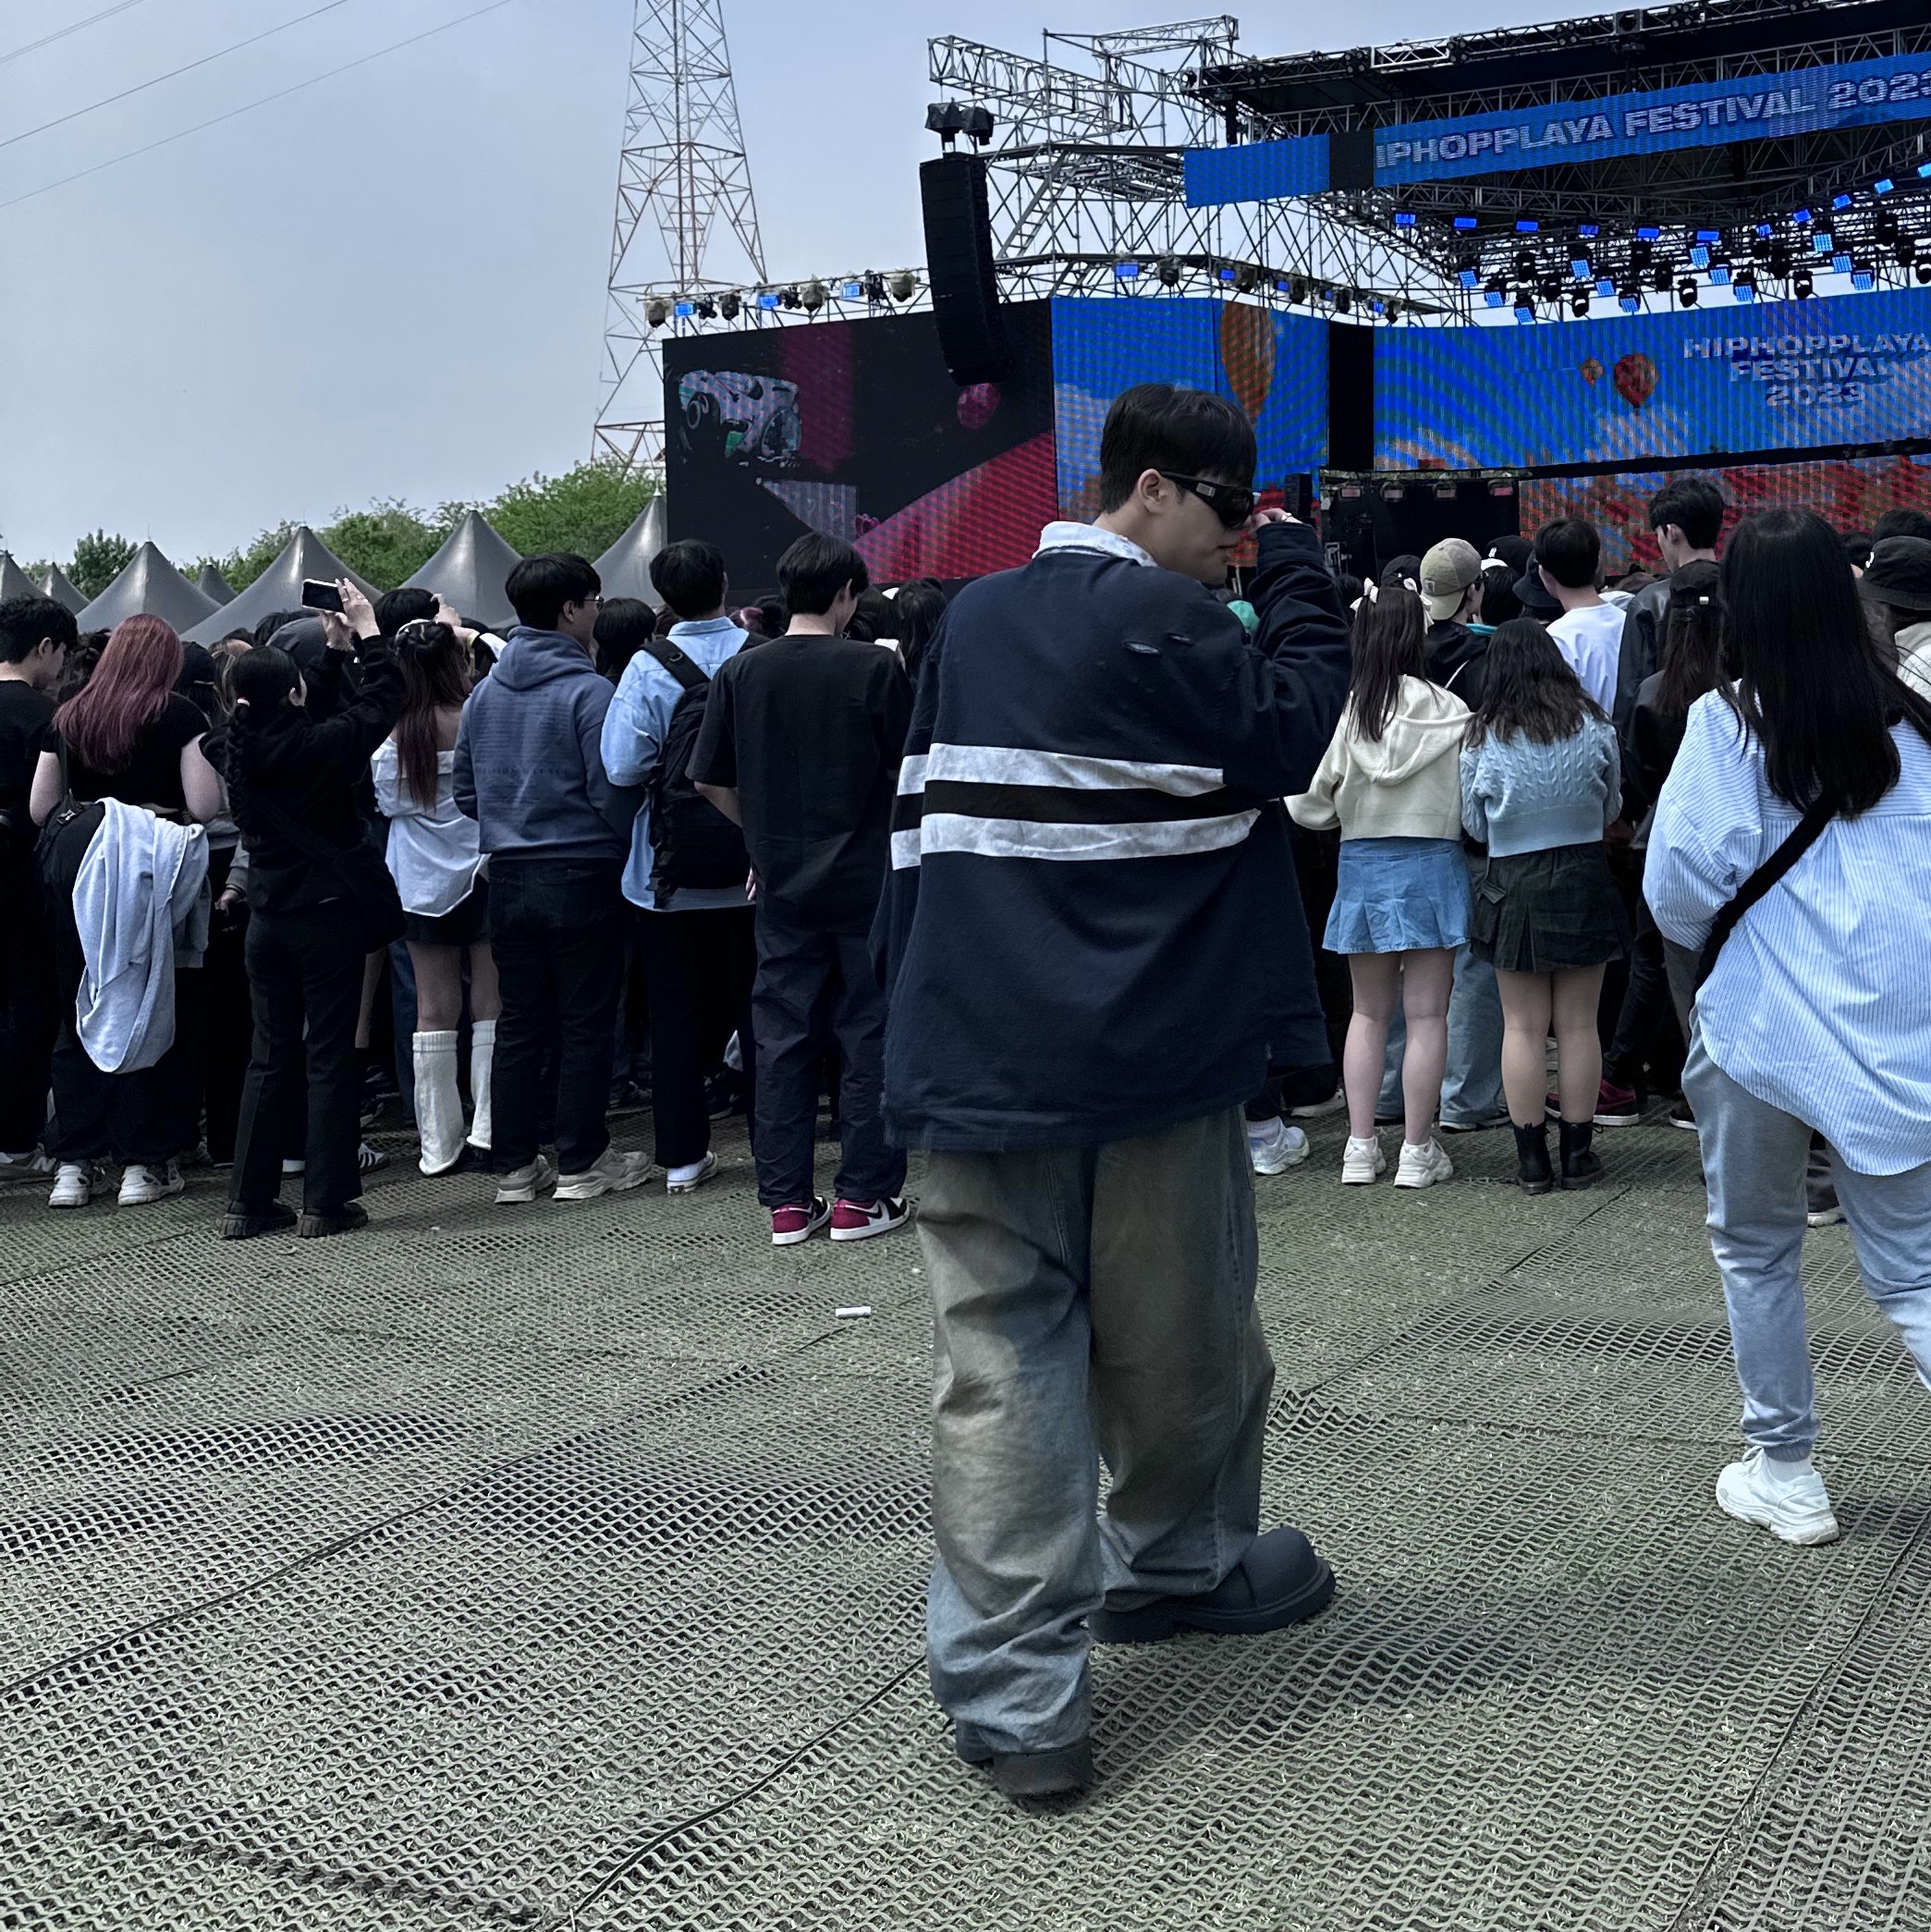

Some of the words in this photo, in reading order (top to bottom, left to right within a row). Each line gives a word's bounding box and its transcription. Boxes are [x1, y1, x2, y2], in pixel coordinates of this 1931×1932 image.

[1625, 88, 1816, 137] FESTIVAL
[1682, 332, 1931, 359] HIPHOPPLAYA
[1766, 381, 1864, 407] 2023
